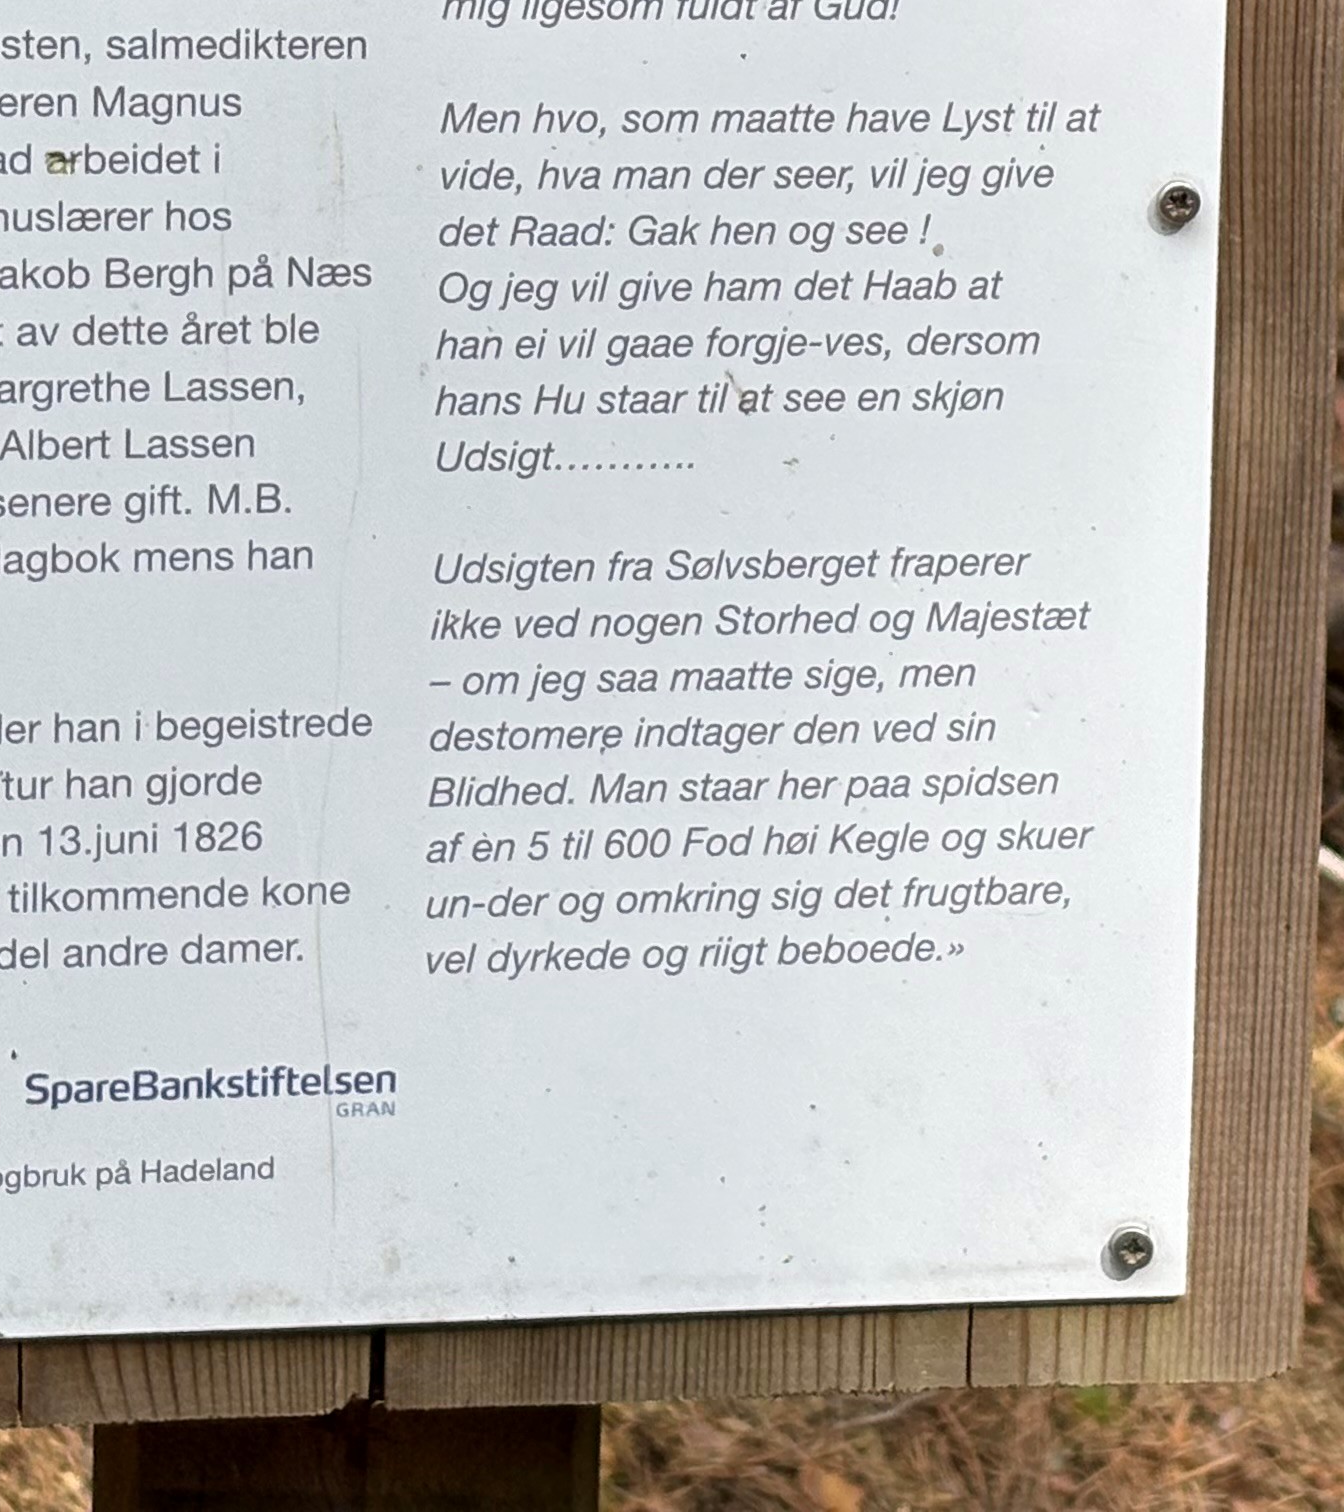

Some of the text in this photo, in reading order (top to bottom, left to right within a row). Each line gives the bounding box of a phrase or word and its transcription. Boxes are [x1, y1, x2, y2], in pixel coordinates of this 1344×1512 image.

[105, 27, 367, 61] salmedikteren
[439, 100, 1103, 142] Men hvo, som maatte have Lyst til at
[43, 142, 202, 176] arbeidet
[214, 142, 221, 174] i
[165, 199, 233, 232] hos
[104, 256, 214, 297] Bergh
[228, 253, 275, 297] på
[287, 255, 373, 288] Næs
[435, 324, 1041, 367] han ei vil gaae forgje-ves, dersom
[164, 369, 305, 407] Lassen,
[124, 483, 192, 525] gift.
[207, 482, 292, 515] M.B.
[434, 545, 1033, 592] Udsigten fra Sølvsberget fraperer
[430, 600, 1092, 645] ikke ved nogen Storhed og Majestæt
[53, 711, 121, 744] han
[135, 709, 142, 742] i
[156, 705, 373, 749] begeistrede
[429, 710, 997, 755] destomere indtager den ved sin
[0, 769, 55, 801] tur
[65, 767, 132, 800] han
[145, 763, 263, 806] gjorde
[38, 822, 158, 864] 13.juni
[173, 820, 263, 853] 1826
[425, 875, 1071, 924] un-der og omkring sig det frugtbare,
[62, 934, 169, 969] andre
[180, 933, 304, 965] damer.
[426, 931, 965, 981] vel dyrkede og riigt beboede.»
[24, 1063, 398, 1110] SpareBankstiftelsen
[335, 1101, 397, 1119] GRAN
[95, 1158, 132, 1192] på
[140, 1155, 275, 1184] Hadeland
